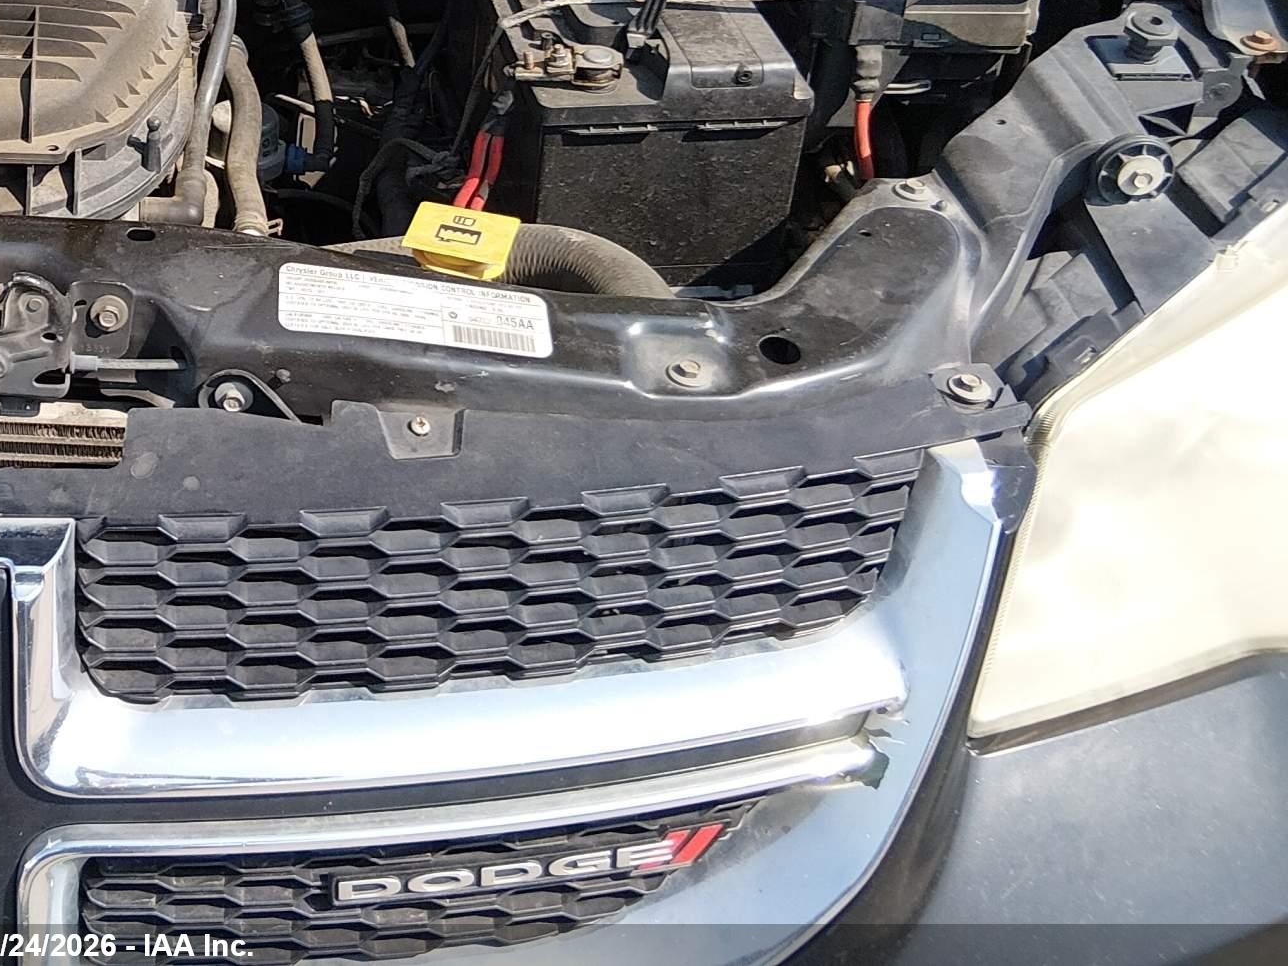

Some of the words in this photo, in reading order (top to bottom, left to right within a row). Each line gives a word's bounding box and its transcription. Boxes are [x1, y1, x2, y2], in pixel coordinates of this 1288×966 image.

[285, 264, 318, 275] Chrysler
[345, 272, 361, 281] LLC
[336, 839, 675, 902] DODGE
